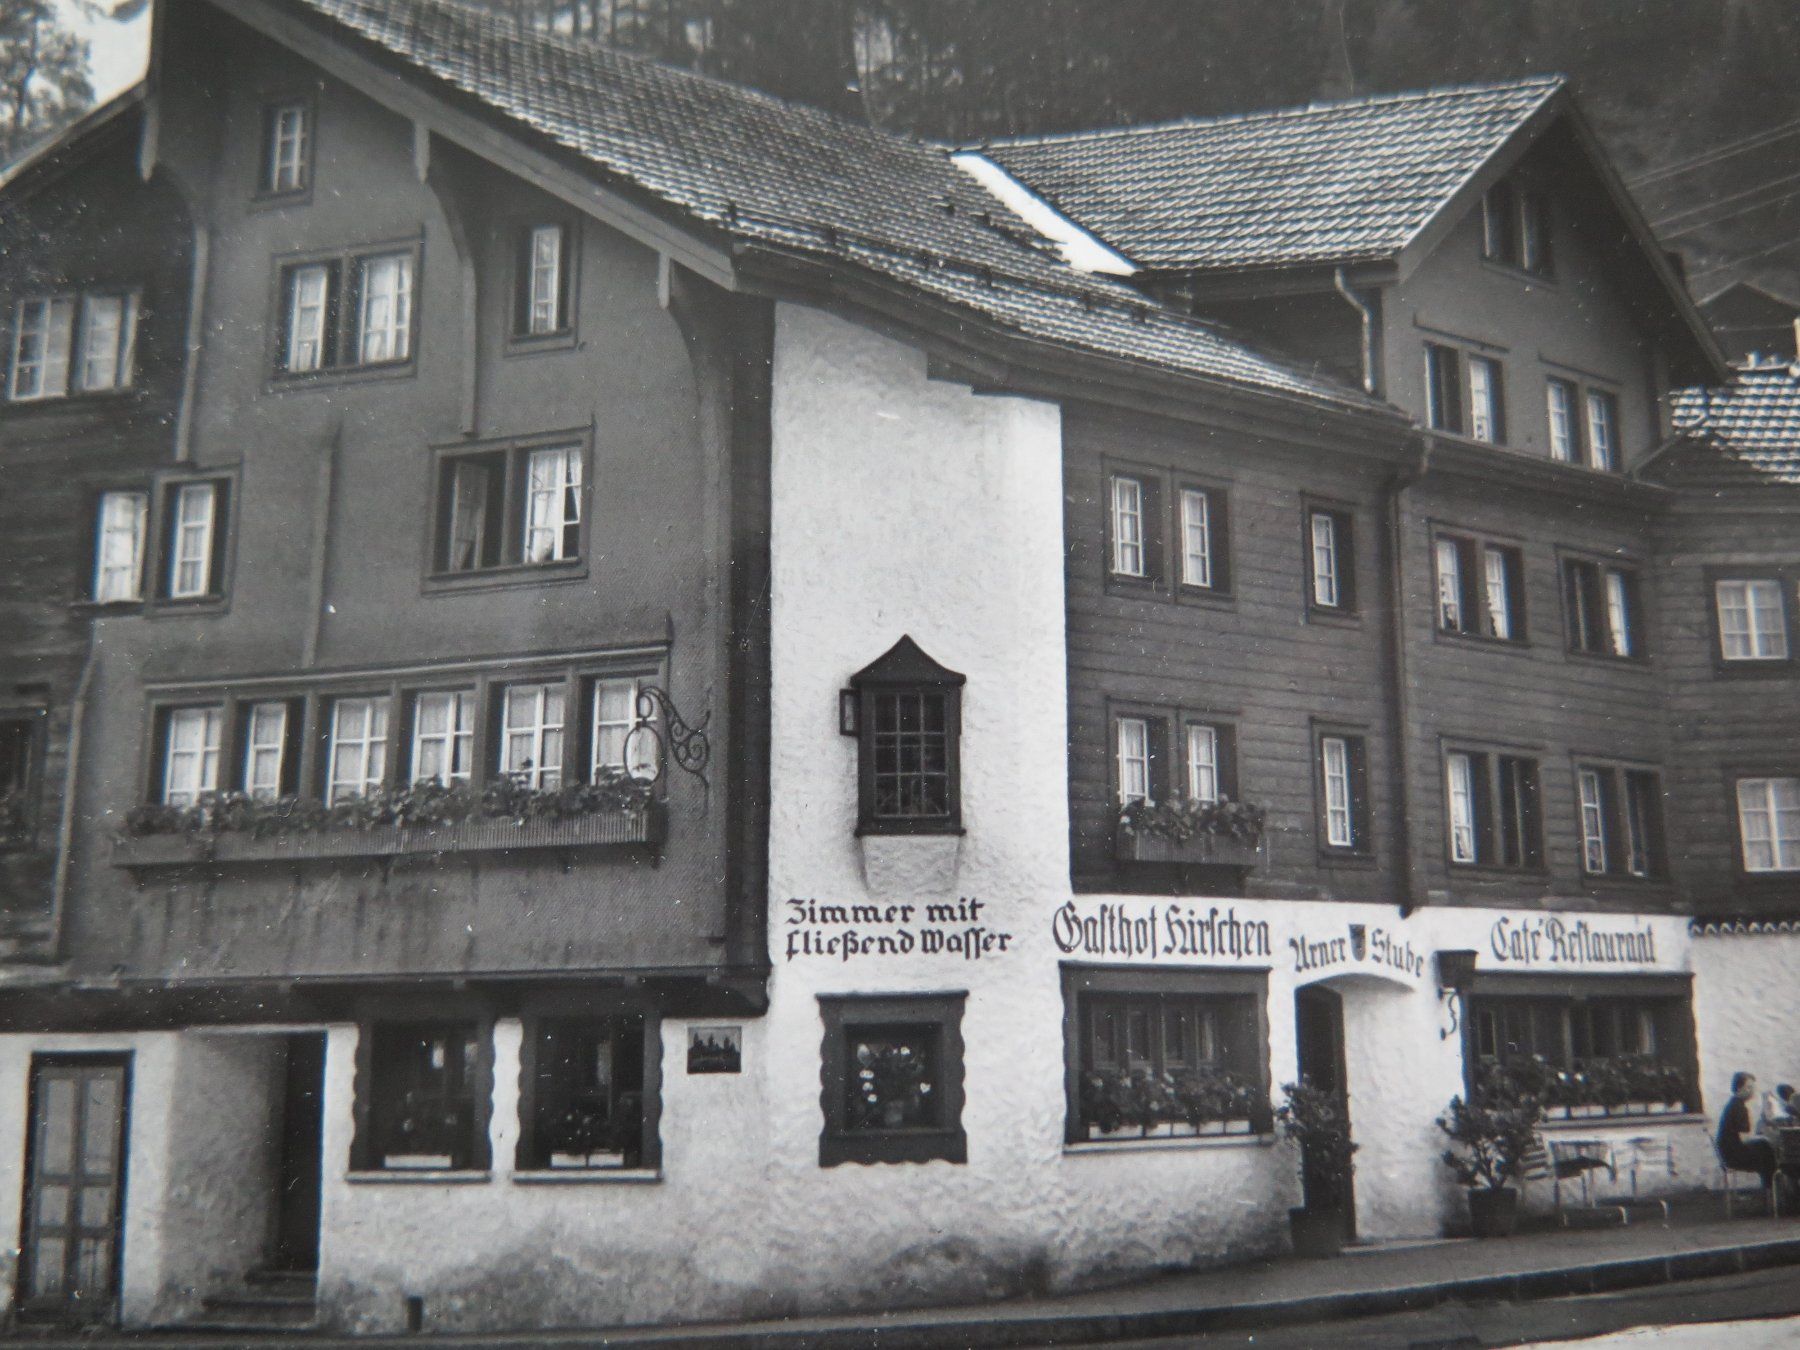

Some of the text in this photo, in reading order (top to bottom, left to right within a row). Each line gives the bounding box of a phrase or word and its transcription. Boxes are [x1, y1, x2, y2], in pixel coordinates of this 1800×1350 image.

[785, 897, 985, 924] Zimmer mit
[1052, 900, 1272, 960] Gasthof Hirschen
[920, 926, 1012, 960] Wasser
[1288, 928, 1424, 978] Urner Stube
[1490, 916, 1657, 965] Café Restaurant
